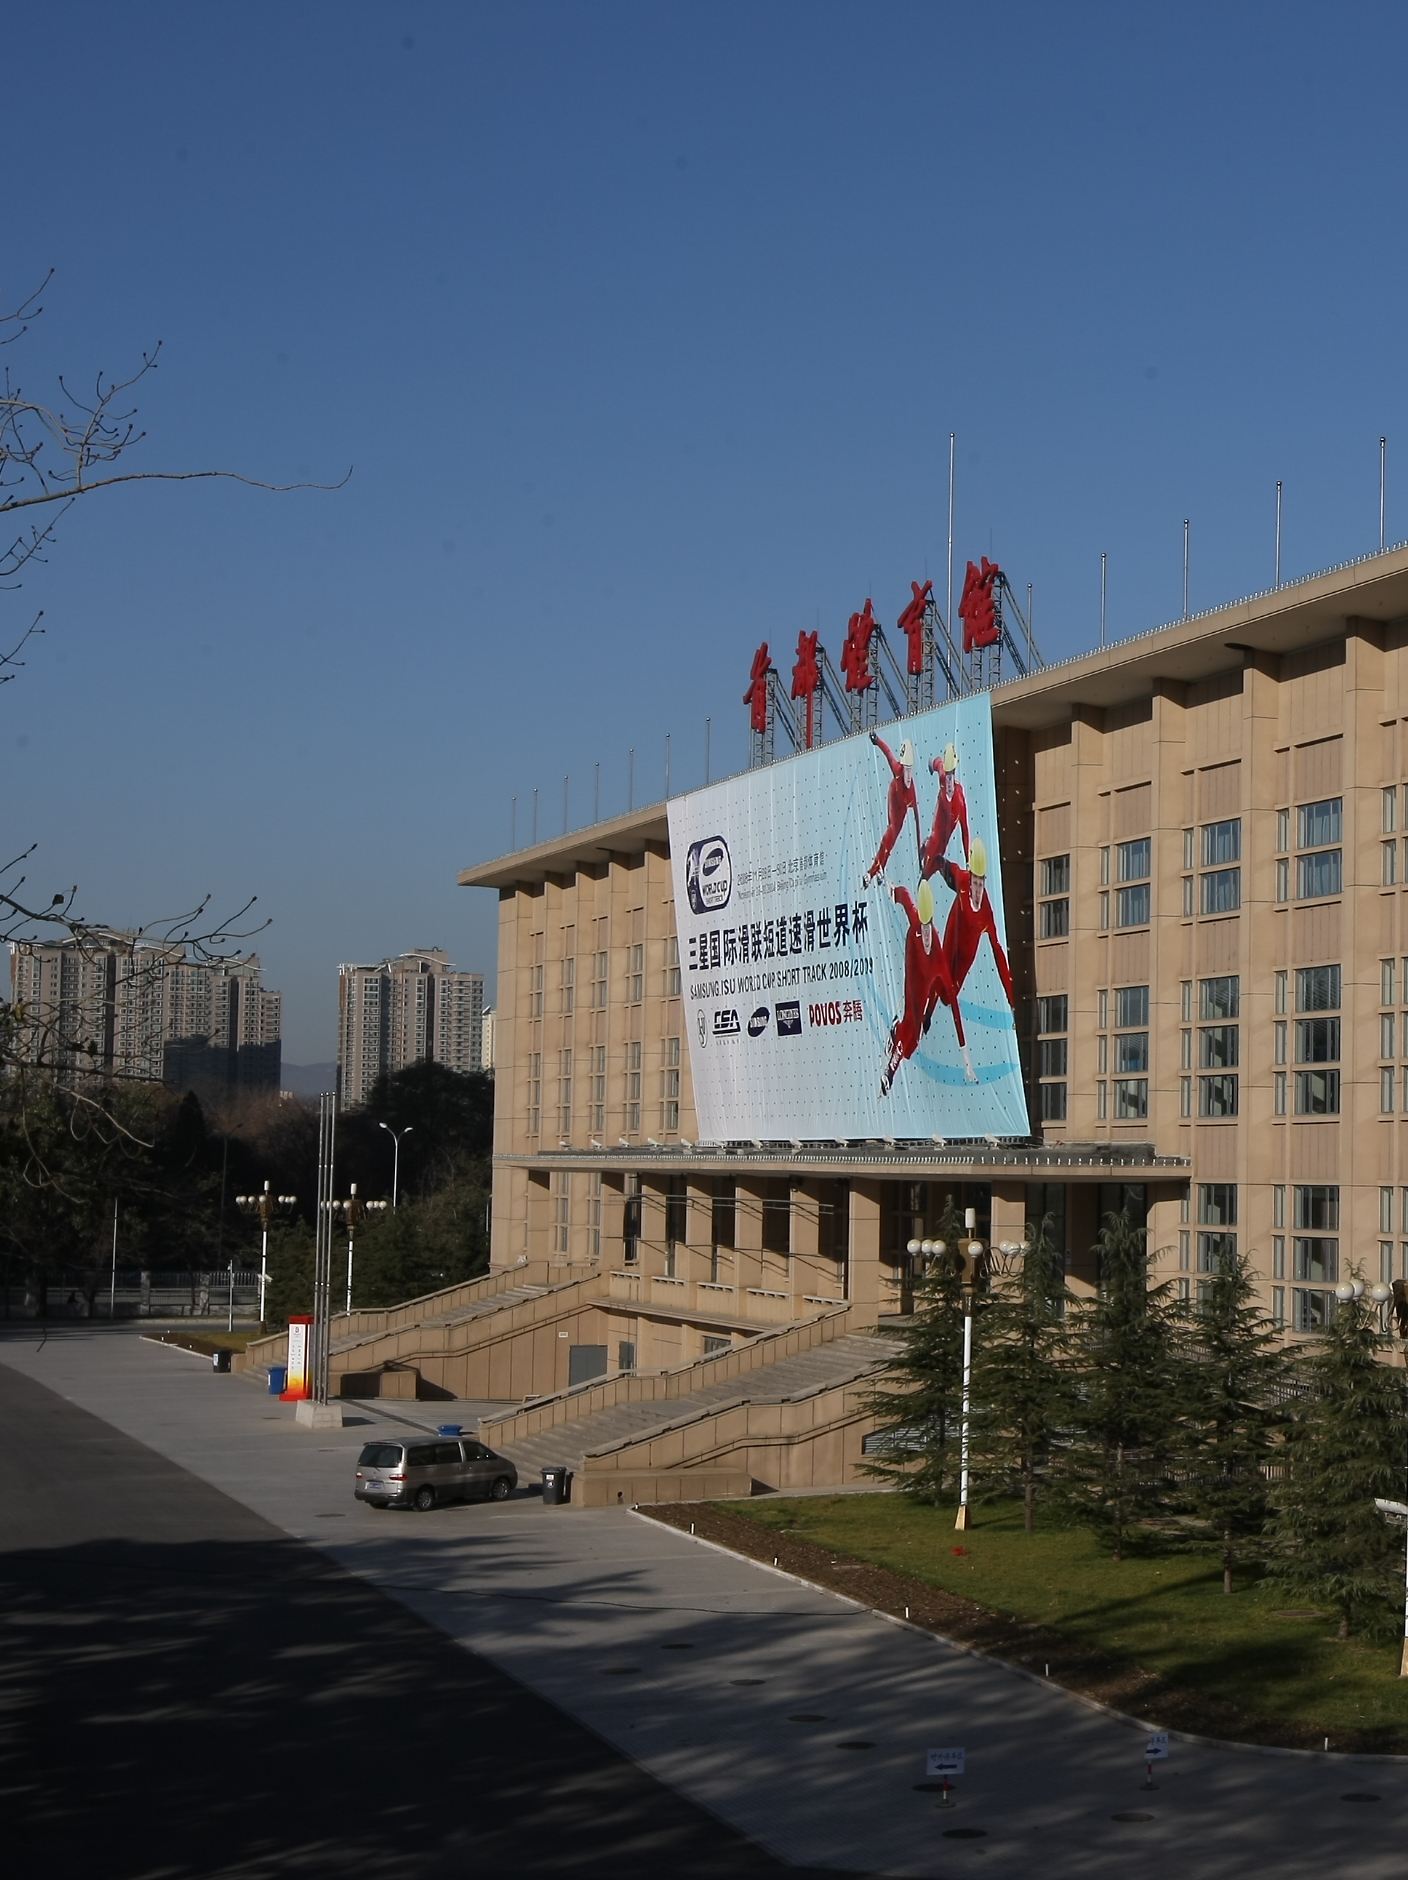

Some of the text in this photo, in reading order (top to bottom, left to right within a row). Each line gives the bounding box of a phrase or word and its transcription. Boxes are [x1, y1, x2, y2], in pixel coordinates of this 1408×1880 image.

[688, 900, 868, 971] 三星国际滑联短道速滑世界杯
[690, 956, 874, 1000] SAMSUNG ISU WORLD CUP SHORT TRACK 2008/2009
[809, 1001, 842, 1028] POVOS
